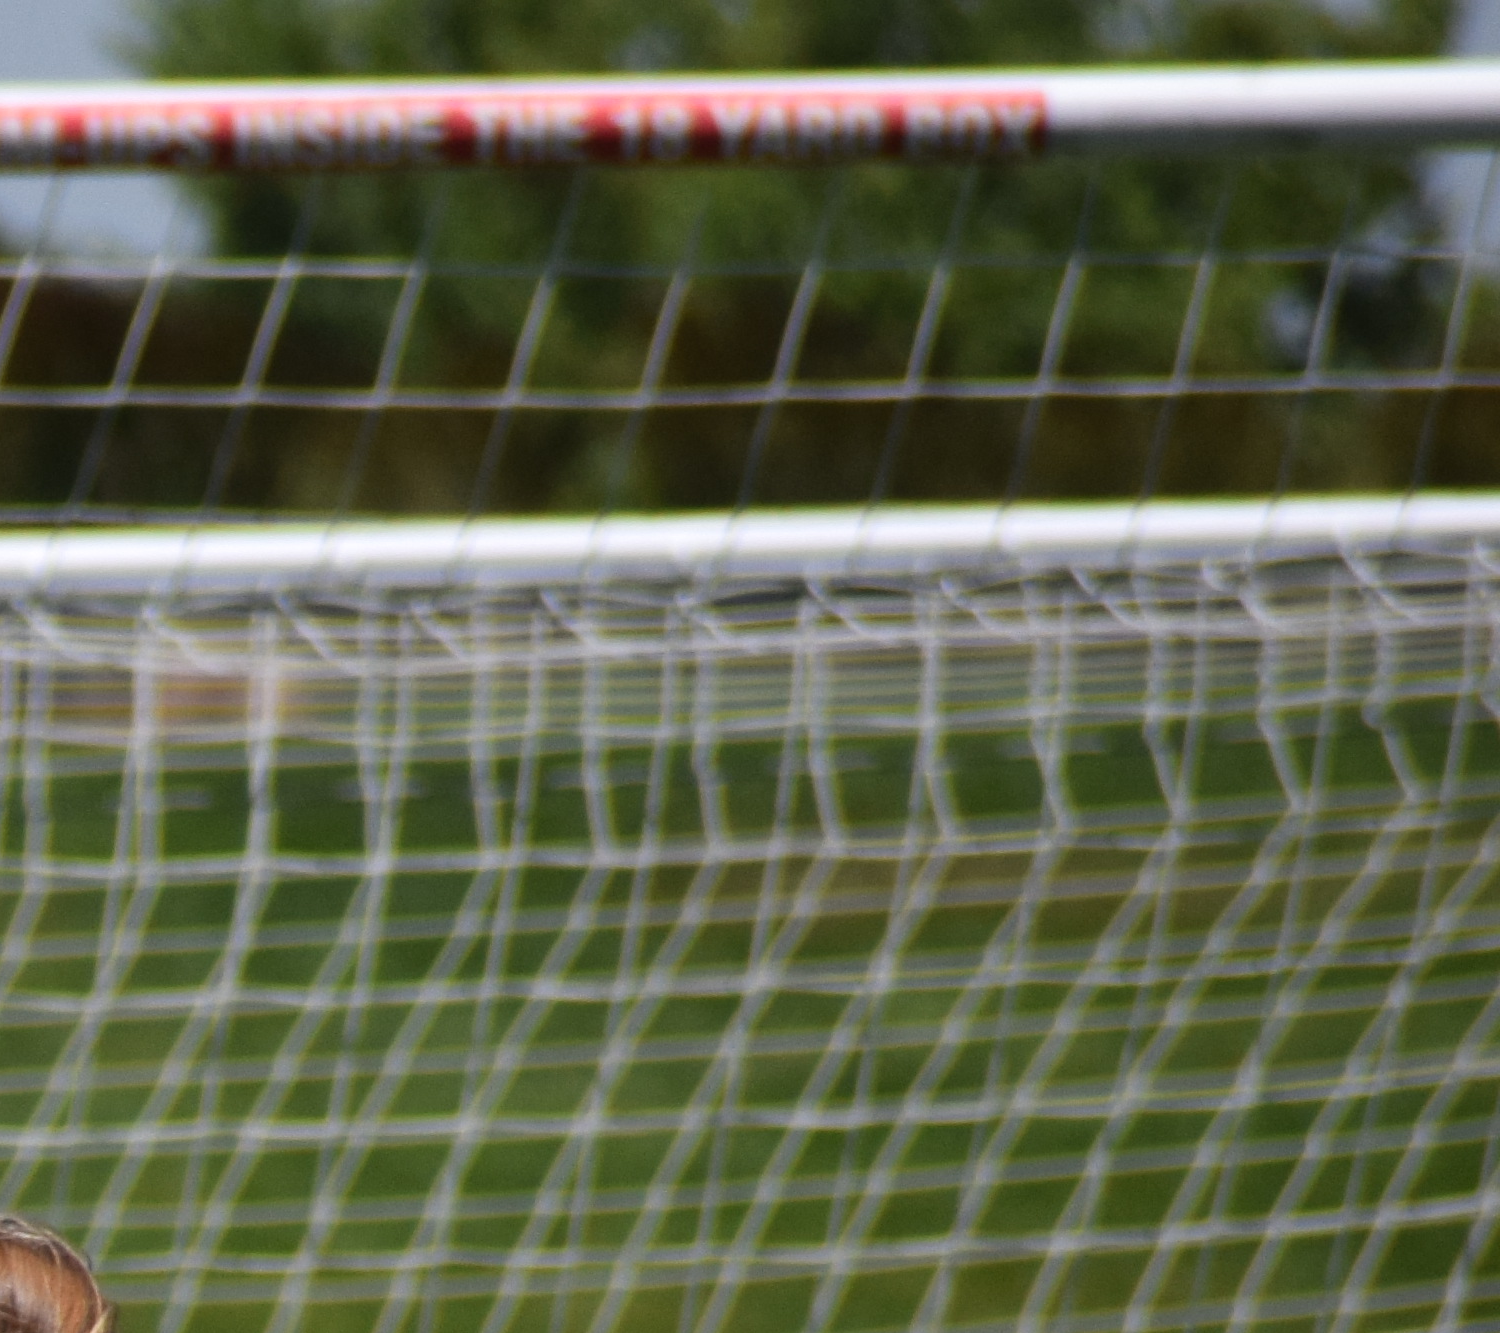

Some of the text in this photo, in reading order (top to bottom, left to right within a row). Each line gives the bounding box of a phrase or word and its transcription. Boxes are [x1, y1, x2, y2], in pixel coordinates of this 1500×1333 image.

[235, 101, 443, 167] INSIDE
[462, 97, 588, 165] THE
[610, 97, 690, 164] 18
[708, 97, 882, 162] YARD
